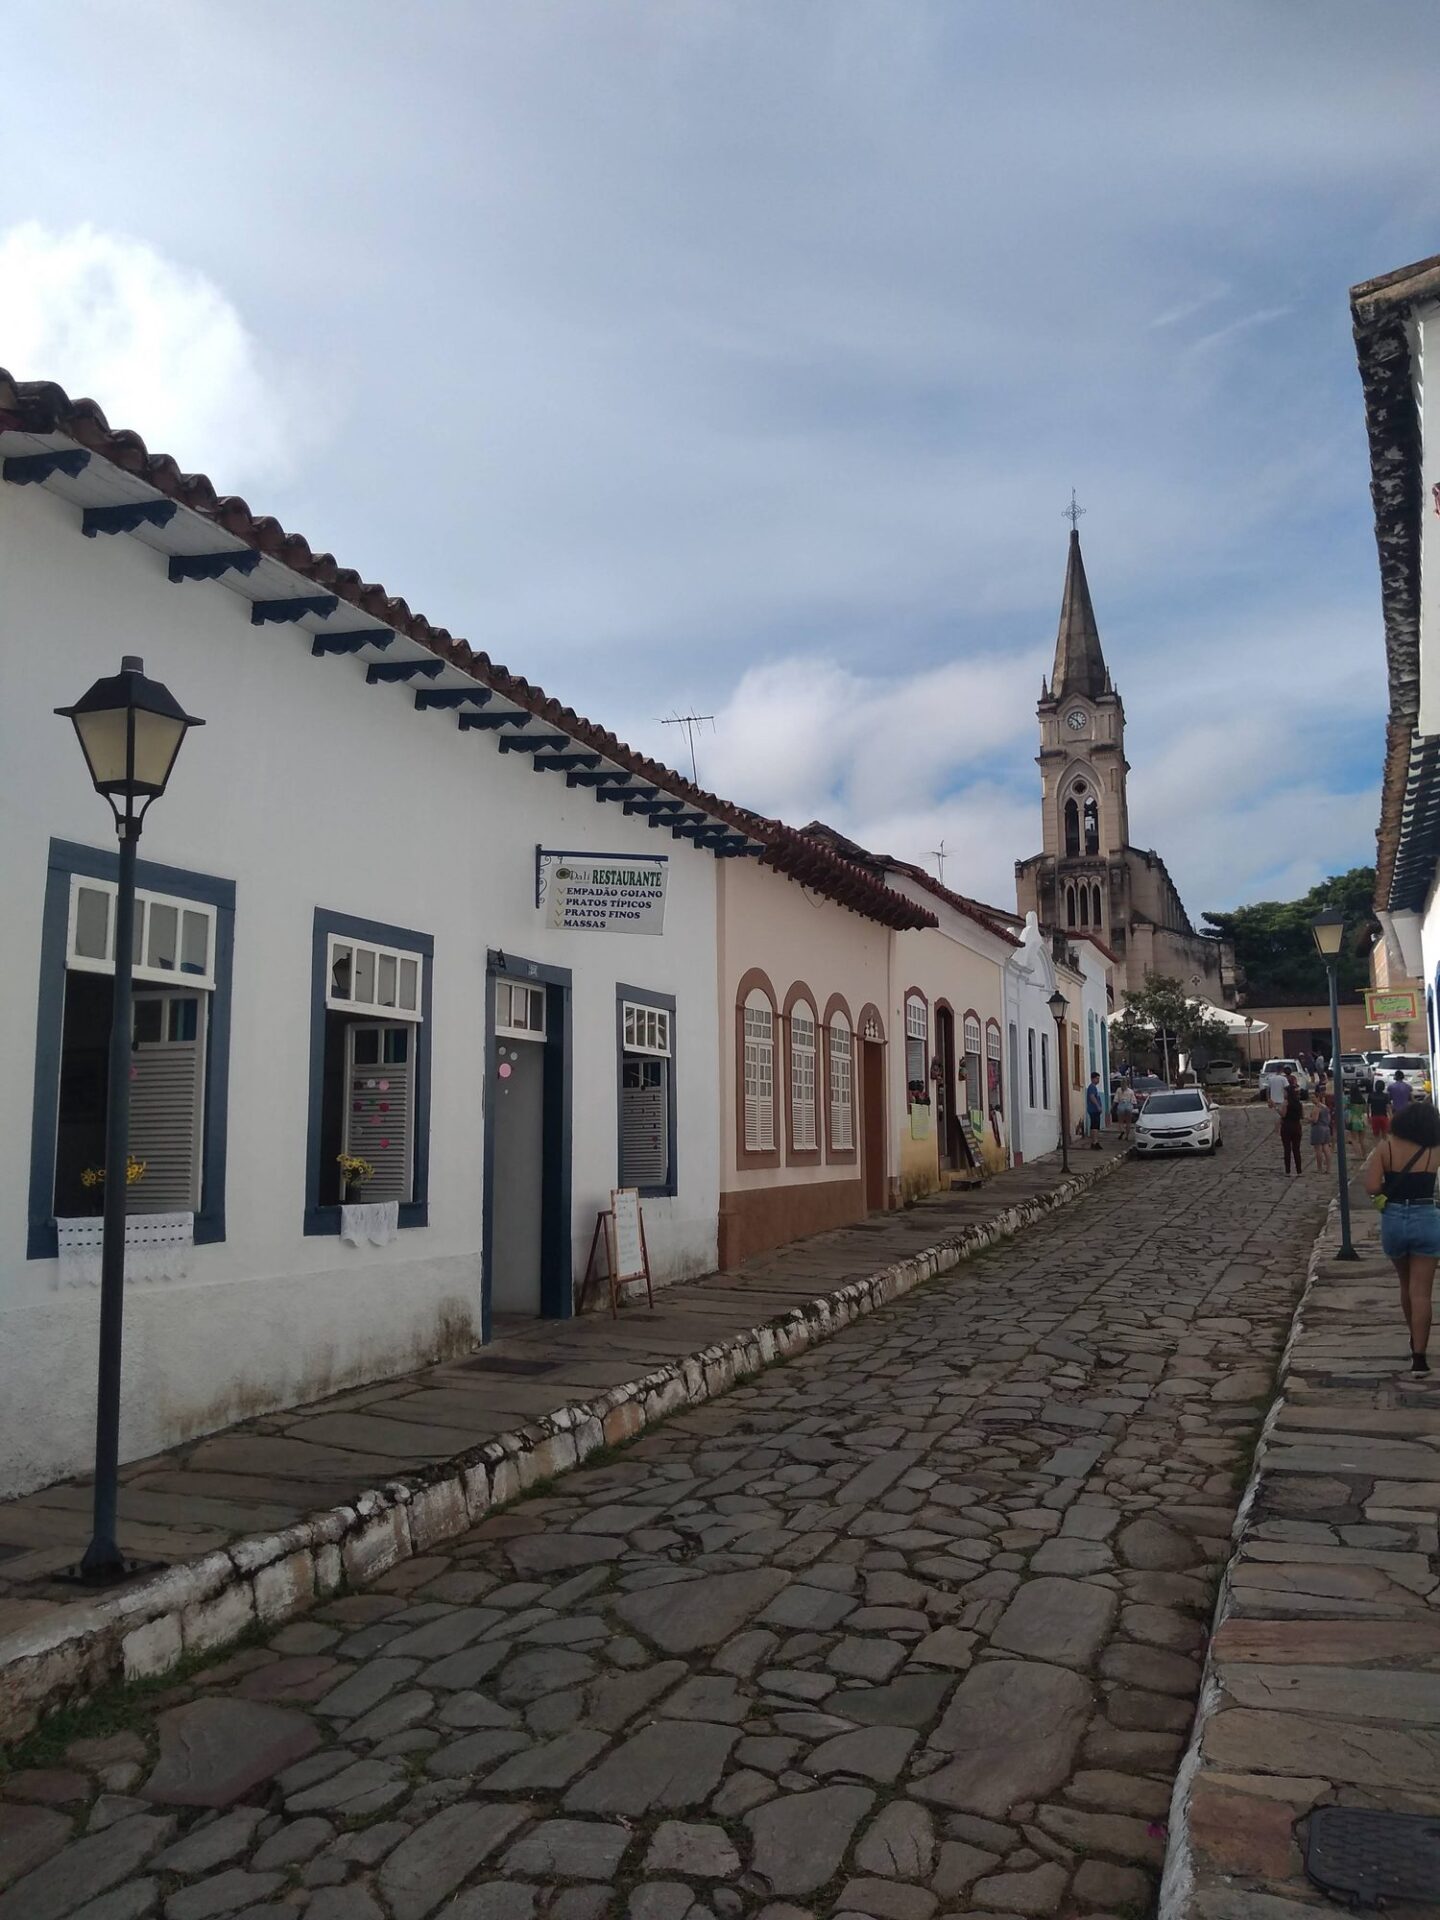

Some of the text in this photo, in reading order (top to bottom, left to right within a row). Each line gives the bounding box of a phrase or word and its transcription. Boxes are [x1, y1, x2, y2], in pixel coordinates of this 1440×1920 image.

[592, 869, 662, 887] RESTAURANTE
[566, 887, 663, 898] EMPADÃO GOIANO
[565, 898, 652, 909] PRATOS TÍPICOS
[564, 909, 641, 919] PRATOS FINOS
[563, 920, 606, 929] MASSAS
